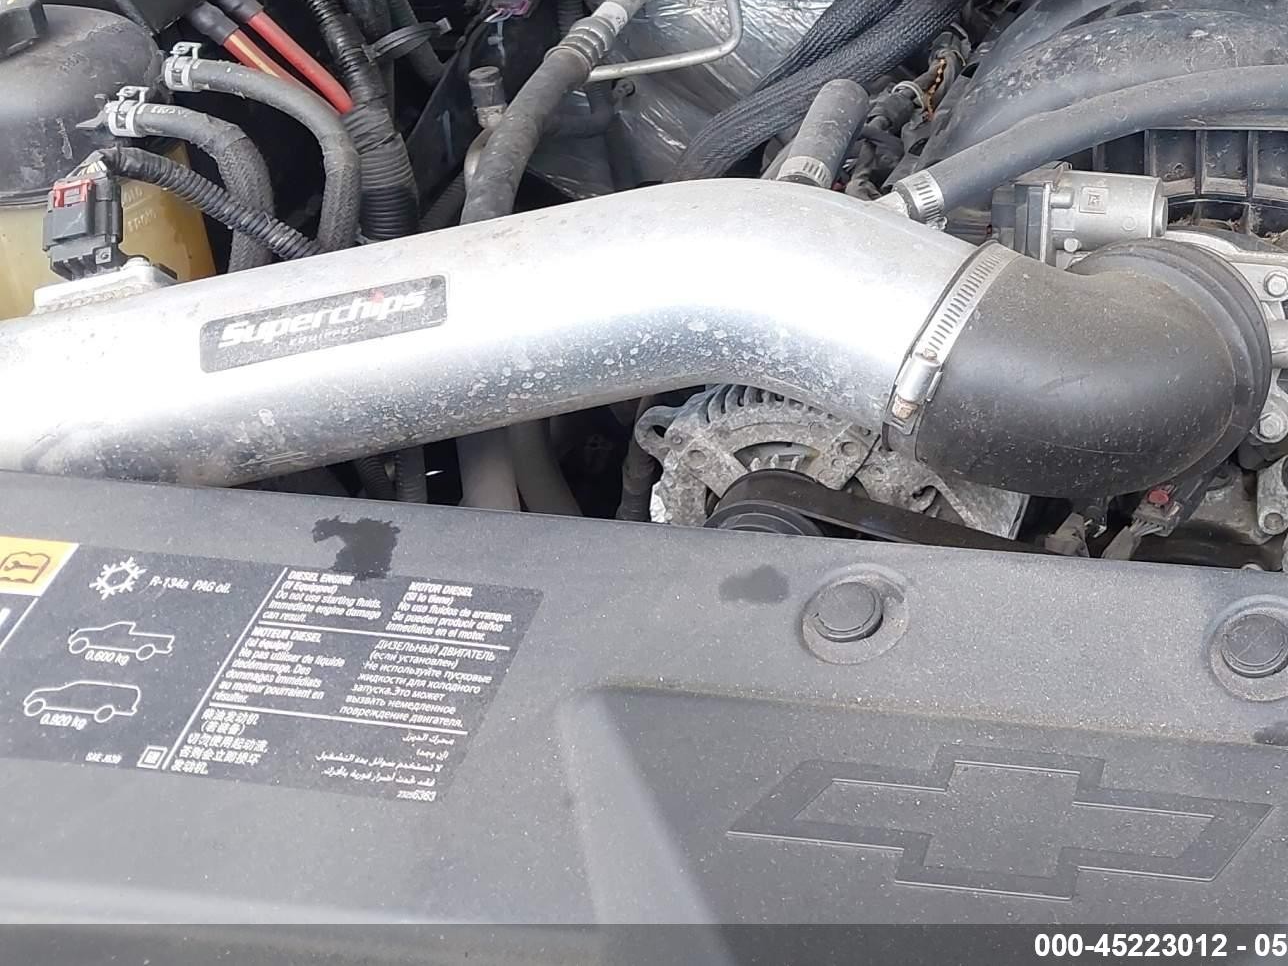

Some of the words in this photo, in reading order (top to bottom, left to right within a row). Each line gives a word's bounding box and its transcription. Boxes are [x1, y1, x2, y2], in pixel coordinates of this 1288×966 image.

[218, 290, 426, 349] Superchips
[150, 575, 190, 590] R-134a
[192, 580, 216, 593] PAG
[216, 583, 232, 594] oil.
[287, 570, 319, 582] DIESEL
[319, 573, 354, 586] ENGINE
[293, 582, 338, 595] Equipped)
[408, 581, 442, 594] MOTOR
[442, 585, 473, 597] DIESEL
[275, 590, 288, 600] Do
[288, 591, 304, 601] not
[304, 594, 321, 603] use
[321, 595, 356, 607] starting
[356, 597, 381, 609] fluids.
[262, 611, 280, 620] can
[280, 613, 306, 622] result.
[268, 600, 315, 613] Immediate
[315, 605, 345, 616] engine
[346, 607, 382, 621] damage
[397, 601, 410, 612] No
[411, 604, 429, 613] use
[428, 605, 460, 616] fluidos
[459, 608, 471, 617] de
[472, 610, 512, 623] arranque.
[392, 611, 404, 621] Se
[404, 614, 438, 625] pueden
[438, 617, 476, 629] producir
[476, 621, 504, 632] daños
[251, 626, 290, 640] MOTEUR
[290, 630, 322, 643] DIESEL
[434, 628, 448, 637] en
[448, 629, 458, 638] el
[458, 630, 486, 642] motor.
[115, 653, 130, 666] kg
[238, 646, 252, 658] Ne
[251, 650, 270, 660] pas
[270, 650, 302, 663] utiliser
[302, 655, 314, 664] de
[314, 656, 346, 668] liquide
[370, 650, 398, 663] (если
[396, 654, 459, 670] установлен)
[374, 640, 440, 656] ДИЗЕЛЬНЫЙ
[438, 646, 496, 662] ДВИГАТЕЛЬ
[226, 670, 276, 684] dommages
[275, 673, 323, 689] immédiats
[293, 664, 312, 676] Des
[364, 661, 376, 672] Не
[379, 662, 442, 678] используйте
[443, 670, 493, 684] пусковые
[218, 680, 232, 690] au
[232, 682, 265, 694] moteur
[264, 686, 312, 699] pourraient
[312, 691, 326, 700] en
[358, 673, 406, 686] жидкости
[406, 678, 426, 688] для
[426, 680, 481, 694] холодного
[212, 691, 249, 704] résulter.
[345, 694, 386, 707] вызвать
[387, 700, 456, 715] немедленное
[411, 690, 446, 700] может
[71, 716, 88, 730] kg
[339, 706, 410, 722] повреждение
[408, 714, 464, 728] двигателя.
